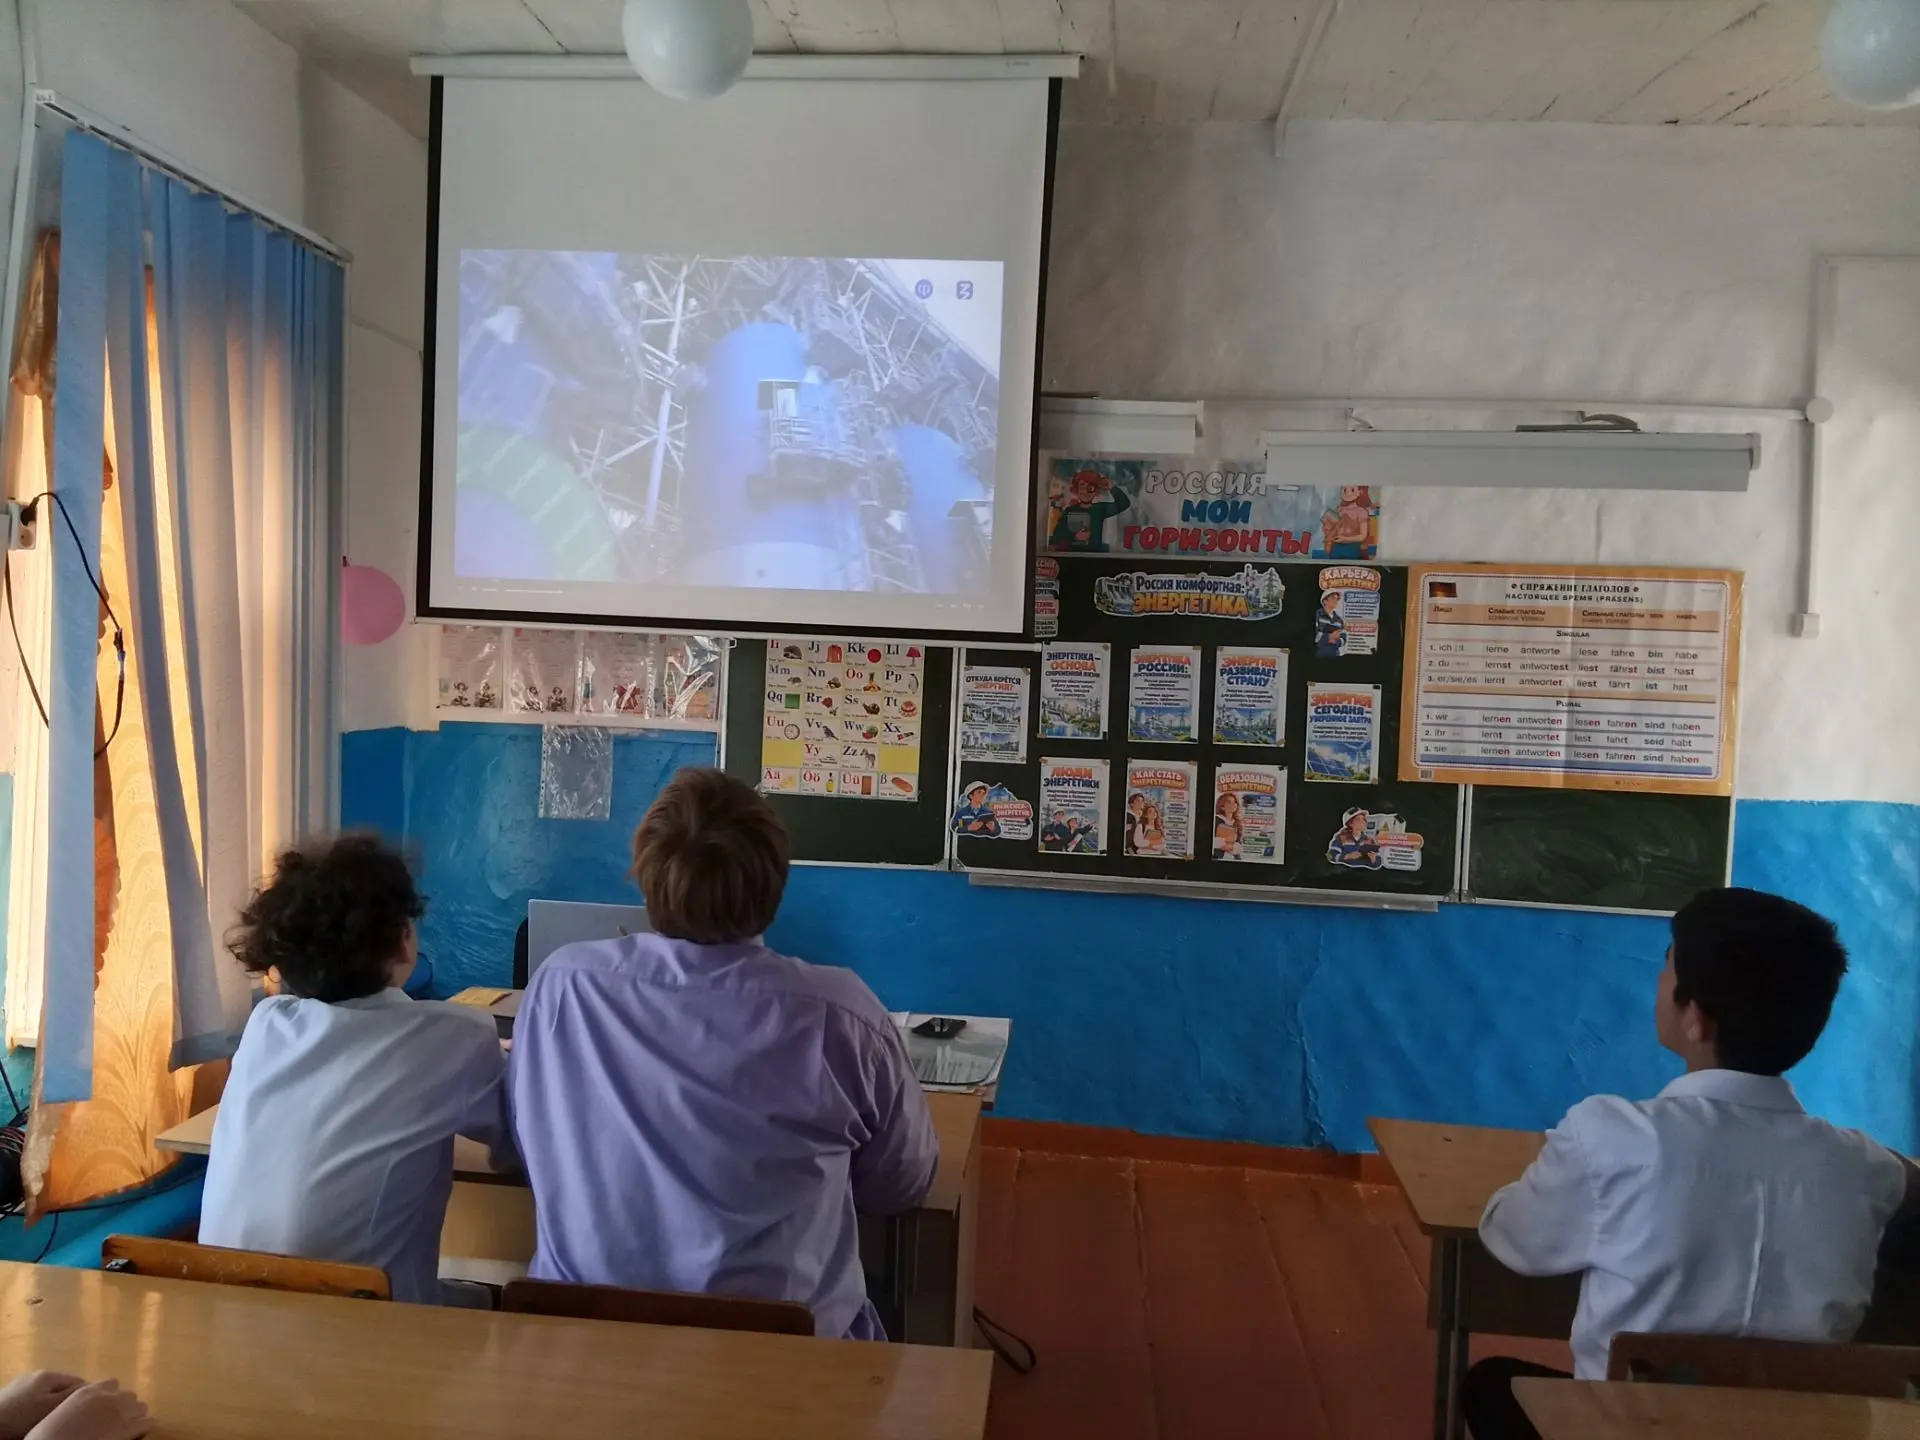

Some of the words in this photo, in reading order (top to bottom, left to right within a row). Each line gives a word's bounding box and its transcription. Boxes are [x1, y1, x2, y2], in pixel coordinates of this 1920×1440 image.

[1145, 470, 1266, 496] РОССИЯ
[1180, 499, 1252, 524] МОИ
[1123, 525, 1312, 555] ГОРИЗОНТЫ
[1324, 568, 1375, 581] КАРЬЕРА
[1136, 575, 1174, 591] Россия
[1175, 577, 1246, 594] комфортная:
[1519, 582, 1578, 592] СПРЯЖЕНИЕ
[1581, 585, 1630, 594] ГЛАГОЛОВ
[1505, 593, 1560, 601] НАСТОЯЩЕЕ
[1132, 592, 1249, 616] ЭНЕРГЕТИКА
[808, 641, 820, 654] Jj
[847, 642, 866, 654] Kk
[1438, 643, 1452, 651] ich
[1486, 645, 1509, 653] lerne
[1520, 646, 1561, 655] antworte
[1578, 647, 1598, 656] lese
[1648, 650, 1663, 658] bin
[1674, 651, 1699, 660] habe
[1046, 651, 1094, 662] ЭНЕРГЕТИКА
[768, 665, 790, 675] Mm
[808, 666, 826, 677] Nn
[1050, 660, 1097, 672] ОСНОВА
[1137, 663, 1188, 674] РОССИИ:
[1220, 666, 1278, 678] РАЗВИВАЕТ
[1438, 658, 1450, 667] du
[1485, 660, 1511, 669] lernst
[1519, 662, 1569, 671] antwortest
[1578, 664, 1599, 672] liest
[1646, 666, 1666, 675] bist
[1673, 667, 1695, 676] hast
[846, 668, 863, 679] Oo
[885, 670, 902, 683] Pp
[965, 675, 993, 683] ОТКУДА
[1227, 676, 1269, 687] СТРАНУ
[1437, 675, 1478, 683] er/sie/es
[1484, 676, 1505, 684] lernt
[1519, 677, 1562, 686] antwortet
[1576, 679, 1597, 688] liest
[1645, 682, 1659, 690] ist
[1672, 682, 1689, 691] hat
[767, 690, 783, 703] Qq
[806, 692, 822, 703] Rr
[844, 694, 859, 705] Ss
[883, 696, 898, 707] Tt
[1314, 705, 1364, 716] СЕГОДНЯ
[767, 716, 784, 727] Uu
[805, 717, 823, 728] Vv
[844, 720, 864, 731] Ww
[883, 722, 902, 733] Xx
[1435, 713, 1448, 721] wir
[1482, 714, 1511, 723] lernen
[1517, 716, 1563, 725] antworten
[1575, 718, 1601, 727] lesen
[1607, 719, 1637, 728] fahren
[1644, 721, 1665, 729] sind
[1672, 721, 1701, 731] haben
[1434, 728, 1446, 737] ihr
[1481, 730, 1503, 739] lernt
[1516, 732, 1560, 741] antwortet
[1574, 734, 1592, 743] lest
[1644, 737, 1665, 746] seid
[1671, 738, 1692, 747] habt
[804, 743, 821, 756] Yy
[842, 745, 858, 756] Zz
[1433, 744, 1447, 753] sie
[1481, 746, 1510, 755] lernen
[1515, 747, 1561, 757] antworten
[1573, 750, 1599, 759] lesen
[1605, 751, 1636, 760] fahren
[1643, 753, 1664, 762] sind
[1670, 754, 1700, 763] haben
[1135, 769, 1154, 779] КАК
[1156, 770, 1182, 780] СТАТЬ
[1043, 778, 1099, 789] ЭНЕРГЕТИКИ
